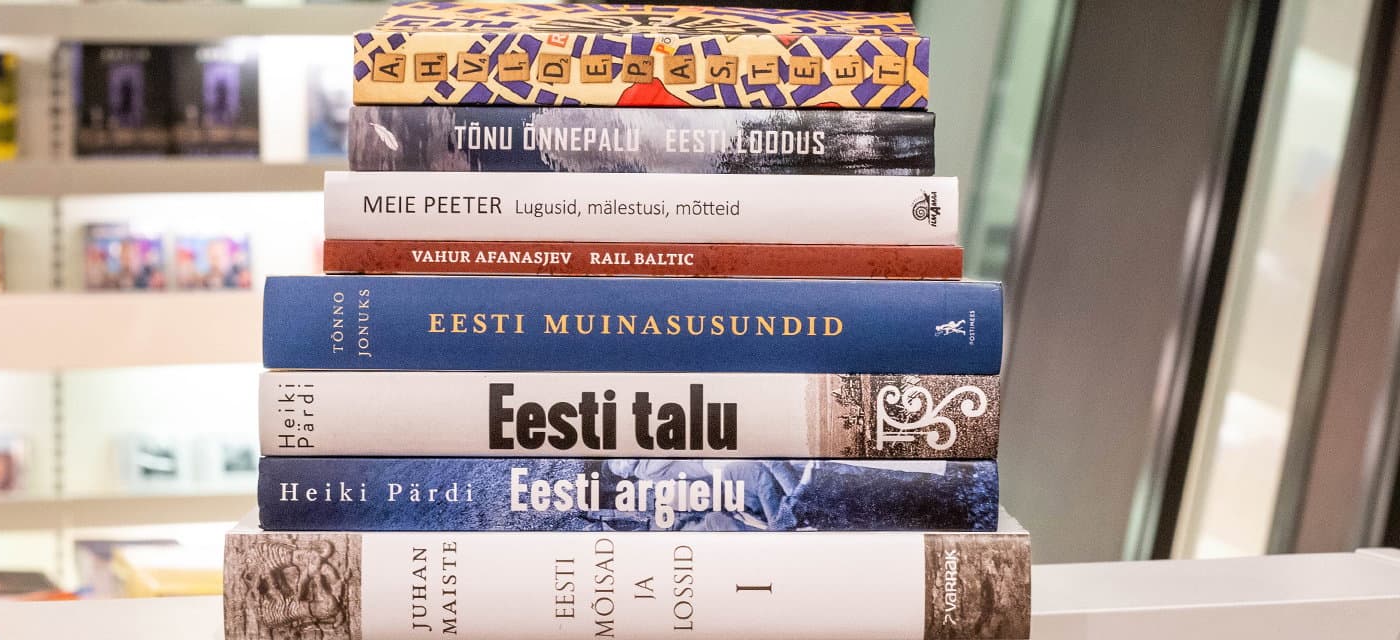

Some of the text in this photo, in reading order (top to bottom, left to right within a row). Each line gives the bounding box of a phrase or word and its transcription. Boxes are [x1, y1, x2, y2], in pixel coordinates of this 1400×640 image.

[455, 121, 825, 155] TÕNU ÕNNEPALU EESTI LOODUS
[363, 196, 740, 218] MEIE PEETER Lugusid, mälestusi, mõtteid
[412, 250, 694, 266] VAHUR AFANASJEV RAIL BALTIC
[330, 291, 345, 354] TÕNNO
[358, 288, 372, 357] JONUKS
[428, 313, 844, 336] EESTI MUINASUSUNDID
[278, 384, 295, 448] Heiki
[297, 384, 314, 448] Pärdi
[489, 383, 738, 451] Eesti talu
[279, 482, 474, 502] Heiki Pärdi
[510, 467, 745, 529] Eesti argielu
[412, 547, 432, 632] JUHAN
[442, 541, 457, 635] MAISTE
[555, 558, 575, 618] EESTI
[590, 538, 615, 638] MÕISAD
[634, 576, 656, 600] JA
[673, 545, 694, 631] LOSSID
[736, 583, 772, 594] I
